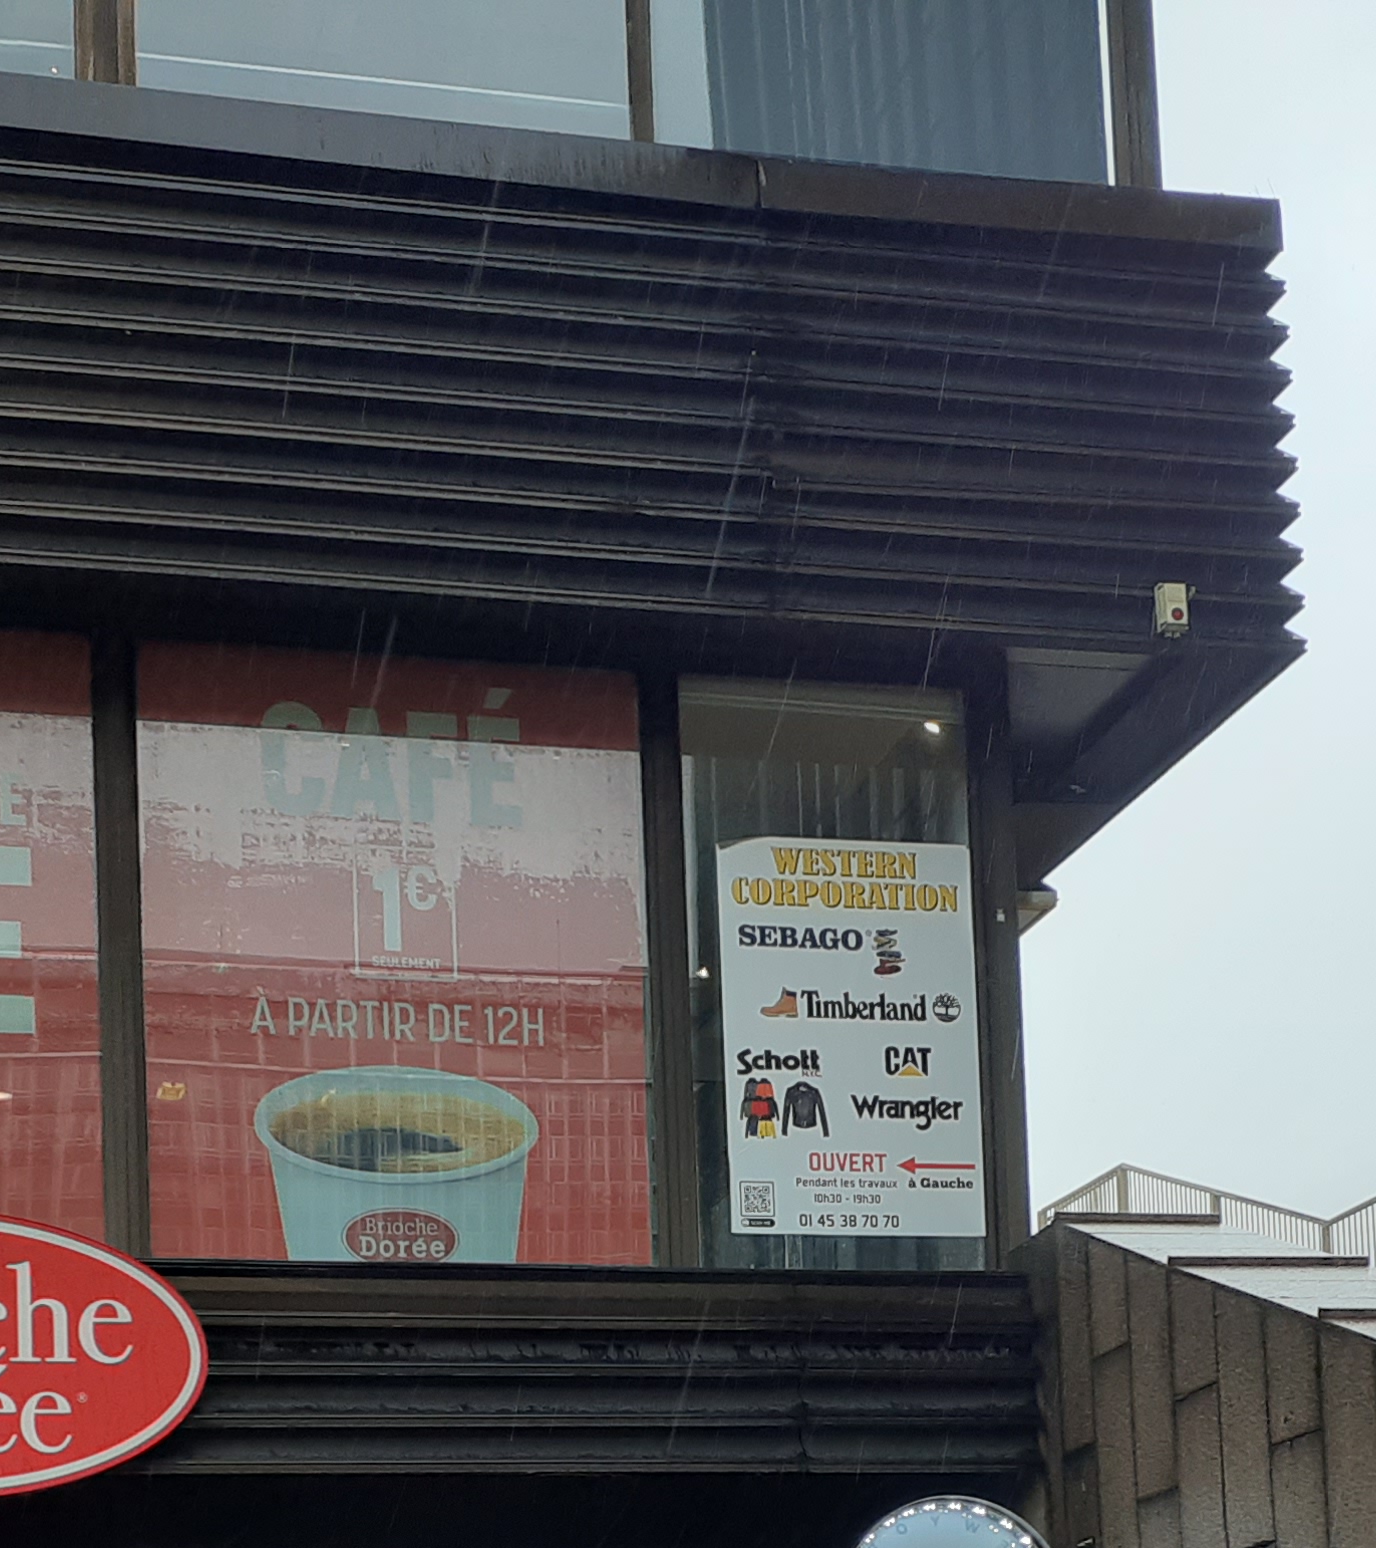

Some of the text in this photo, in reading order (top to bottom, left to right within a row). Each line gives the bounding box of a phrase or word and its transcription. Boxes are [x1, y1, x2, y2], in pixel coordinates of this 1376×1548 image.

[259, 687, 525, 827] CAFÉ
[770, 846, 917, 880] WESTERN
[731, 877, 959, 912] CORPORATION
[738, 924, 863, 951] SEBAGO
[371, 955, 442, 970] SEULEMENT
[250, 985, 545, 1047] À PARTIR DE 12H
[800, 989, 927, 1021] Timberland
[737, 1048, 820, 1075] Schott
[884, 1046, 932, 1077] CAT
[850, 1094, 963, 1131] Wrangler
[809, 1152, 887, 1173] OUVERT
[795, 1177, 898, 1188] Pendant les travaux
[908, 1177, 974, 1189] à Gauche
[814, 1193, 842, 1204] 10h30
[853, 1193, 881, 1204] 19h30
[364, 1217, 439, 1236] Brioche
[799, 1214, 900, 1228] 01 45 38 70 70
[359, 1234, 446, 1259] Dorée
